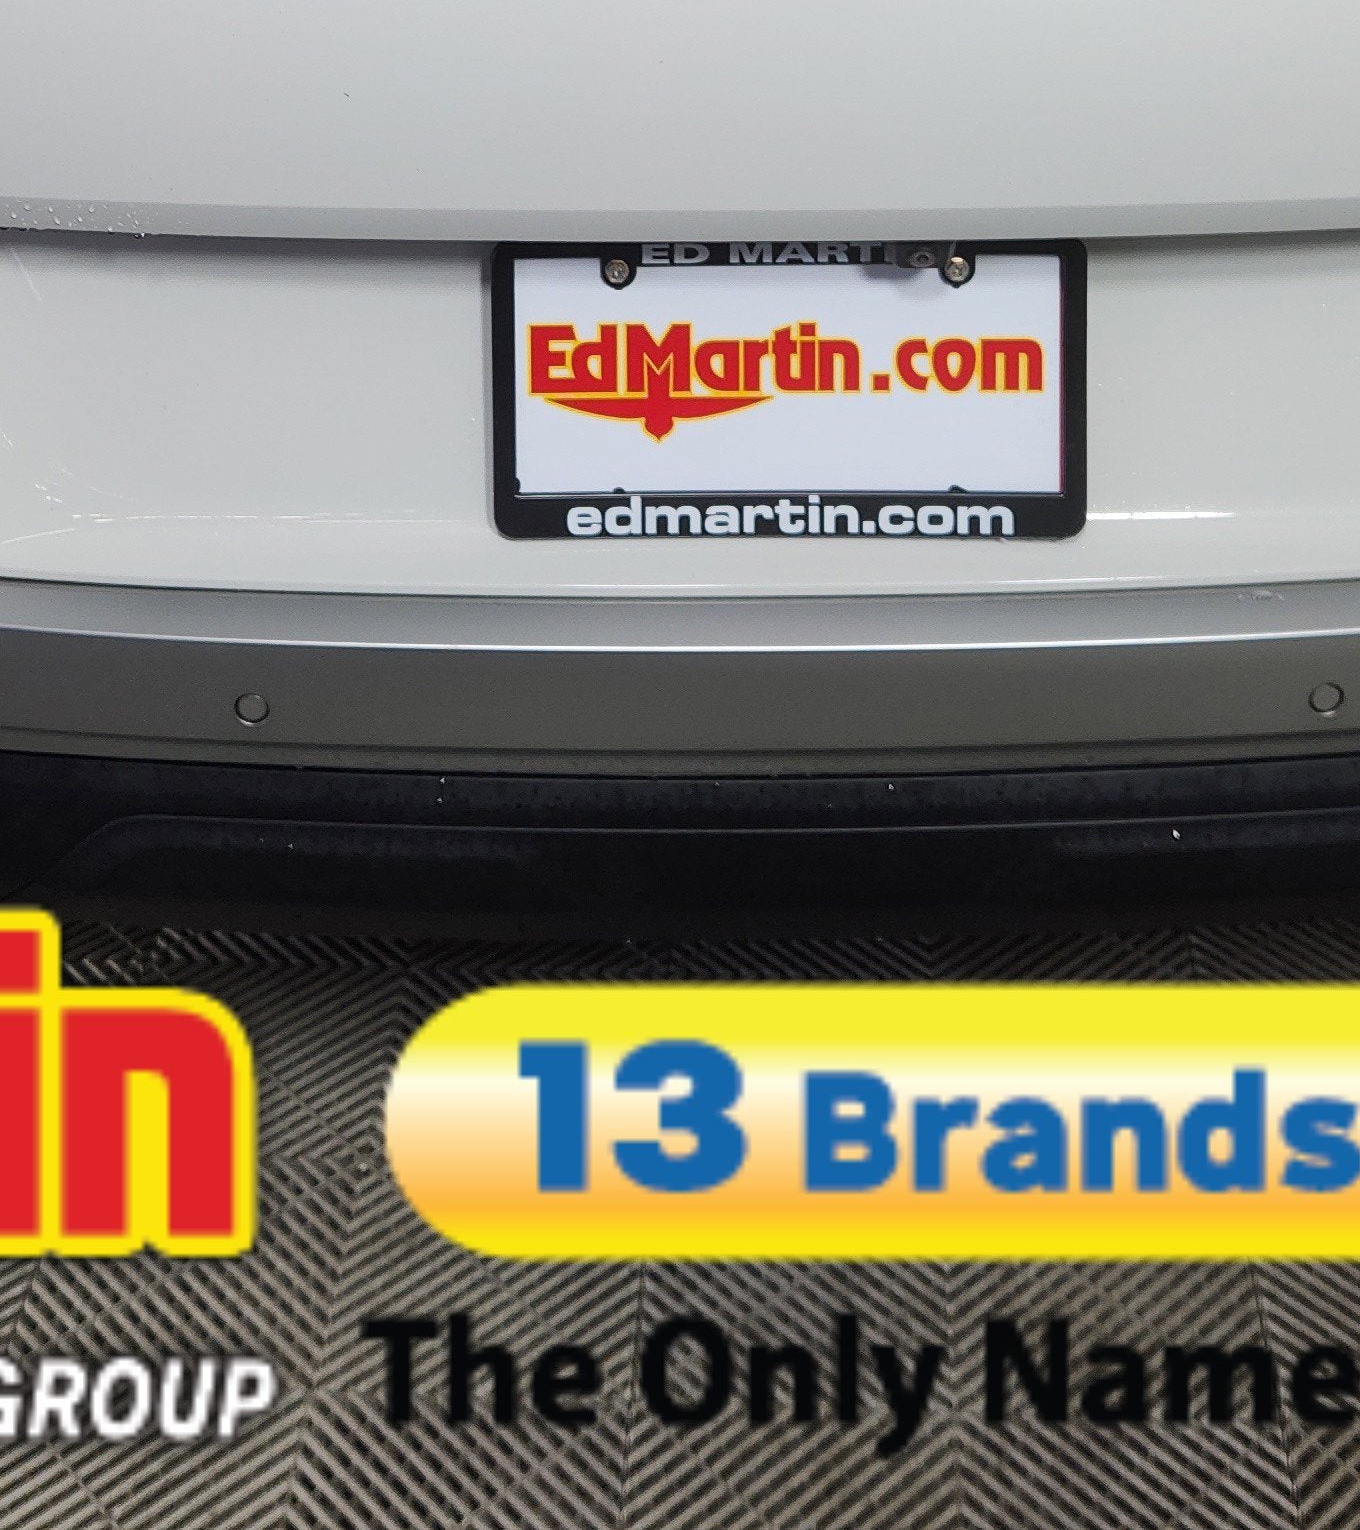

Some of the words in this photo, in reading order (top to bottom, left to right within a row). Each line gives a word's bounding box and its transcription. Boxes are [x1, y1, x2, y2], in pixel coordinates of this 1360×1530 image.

[641, 243, 711, 265] ED
[729, 241, 898, 265] MARTI
[566, 496, 1016, 537] edmartin.com
